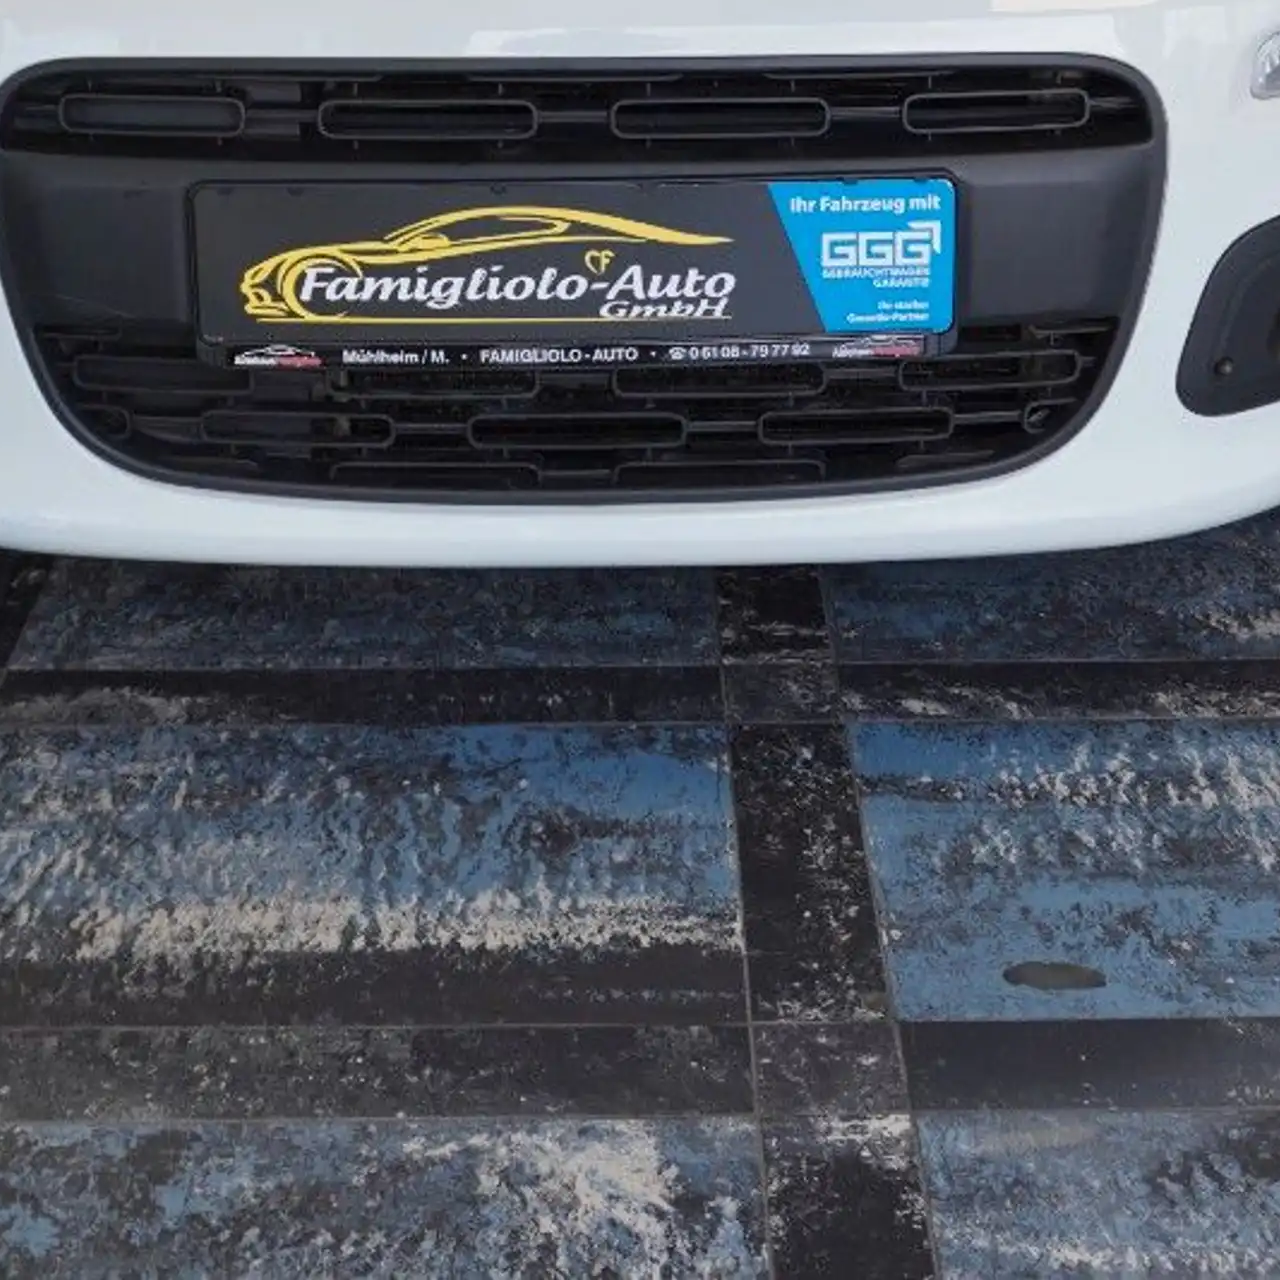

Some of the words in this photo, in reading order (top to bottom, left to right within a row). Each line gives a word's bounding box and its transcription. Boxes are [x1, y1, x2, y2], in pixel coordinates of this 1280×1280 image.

[789, 196, 817, 213] Ihr
[819, 195, 905, 215] Fahrzeug
[908, 194, 941, 211] mit
[821, 231, 932, 267] GGG
[299, 263, 737, 310] Famigliolo-Auto
[598, 299, 730, 319] GmbH
